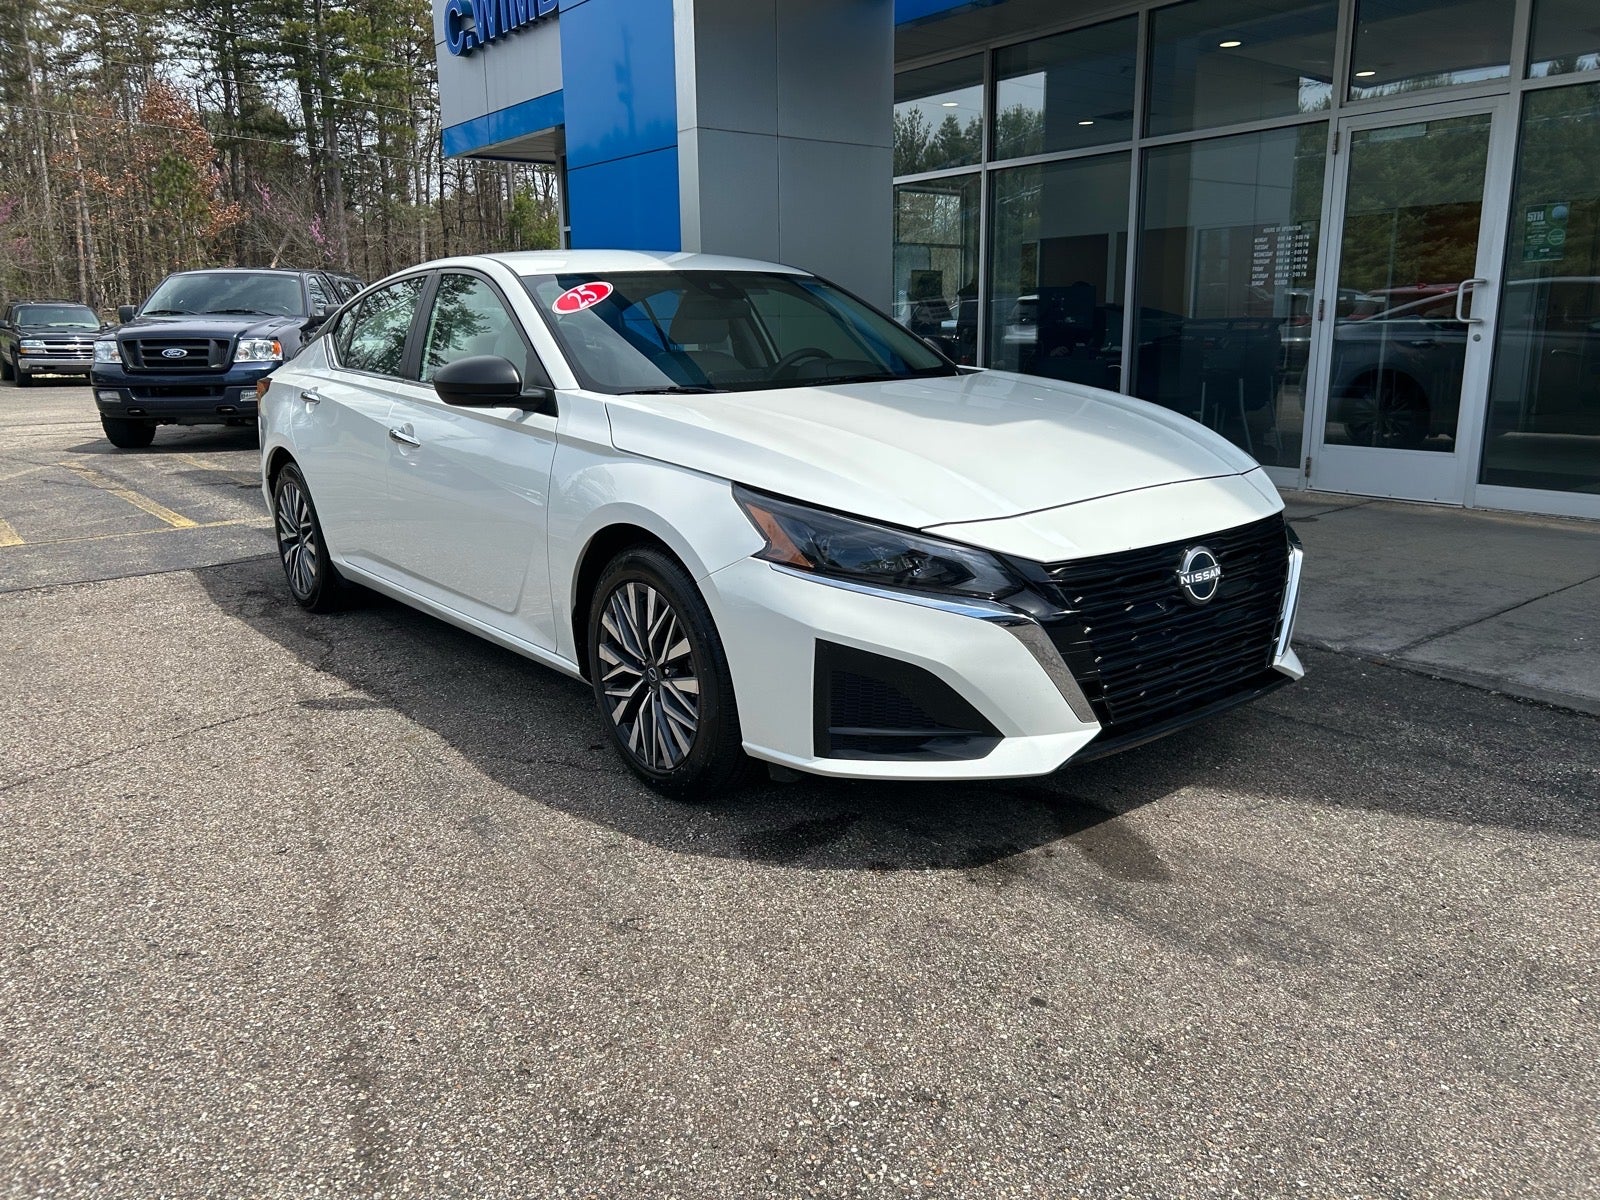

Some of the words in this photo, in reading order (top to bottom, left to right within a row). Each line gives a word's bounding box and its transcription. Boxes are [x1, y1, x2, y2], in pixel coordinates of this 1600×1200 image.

[444, 0, 559, 56] C.WI
[1527, 211, 1544, 222] 5TH
[567, 285, 598, 308] 25
[1180, 566, 1221, 585] NISSAN
